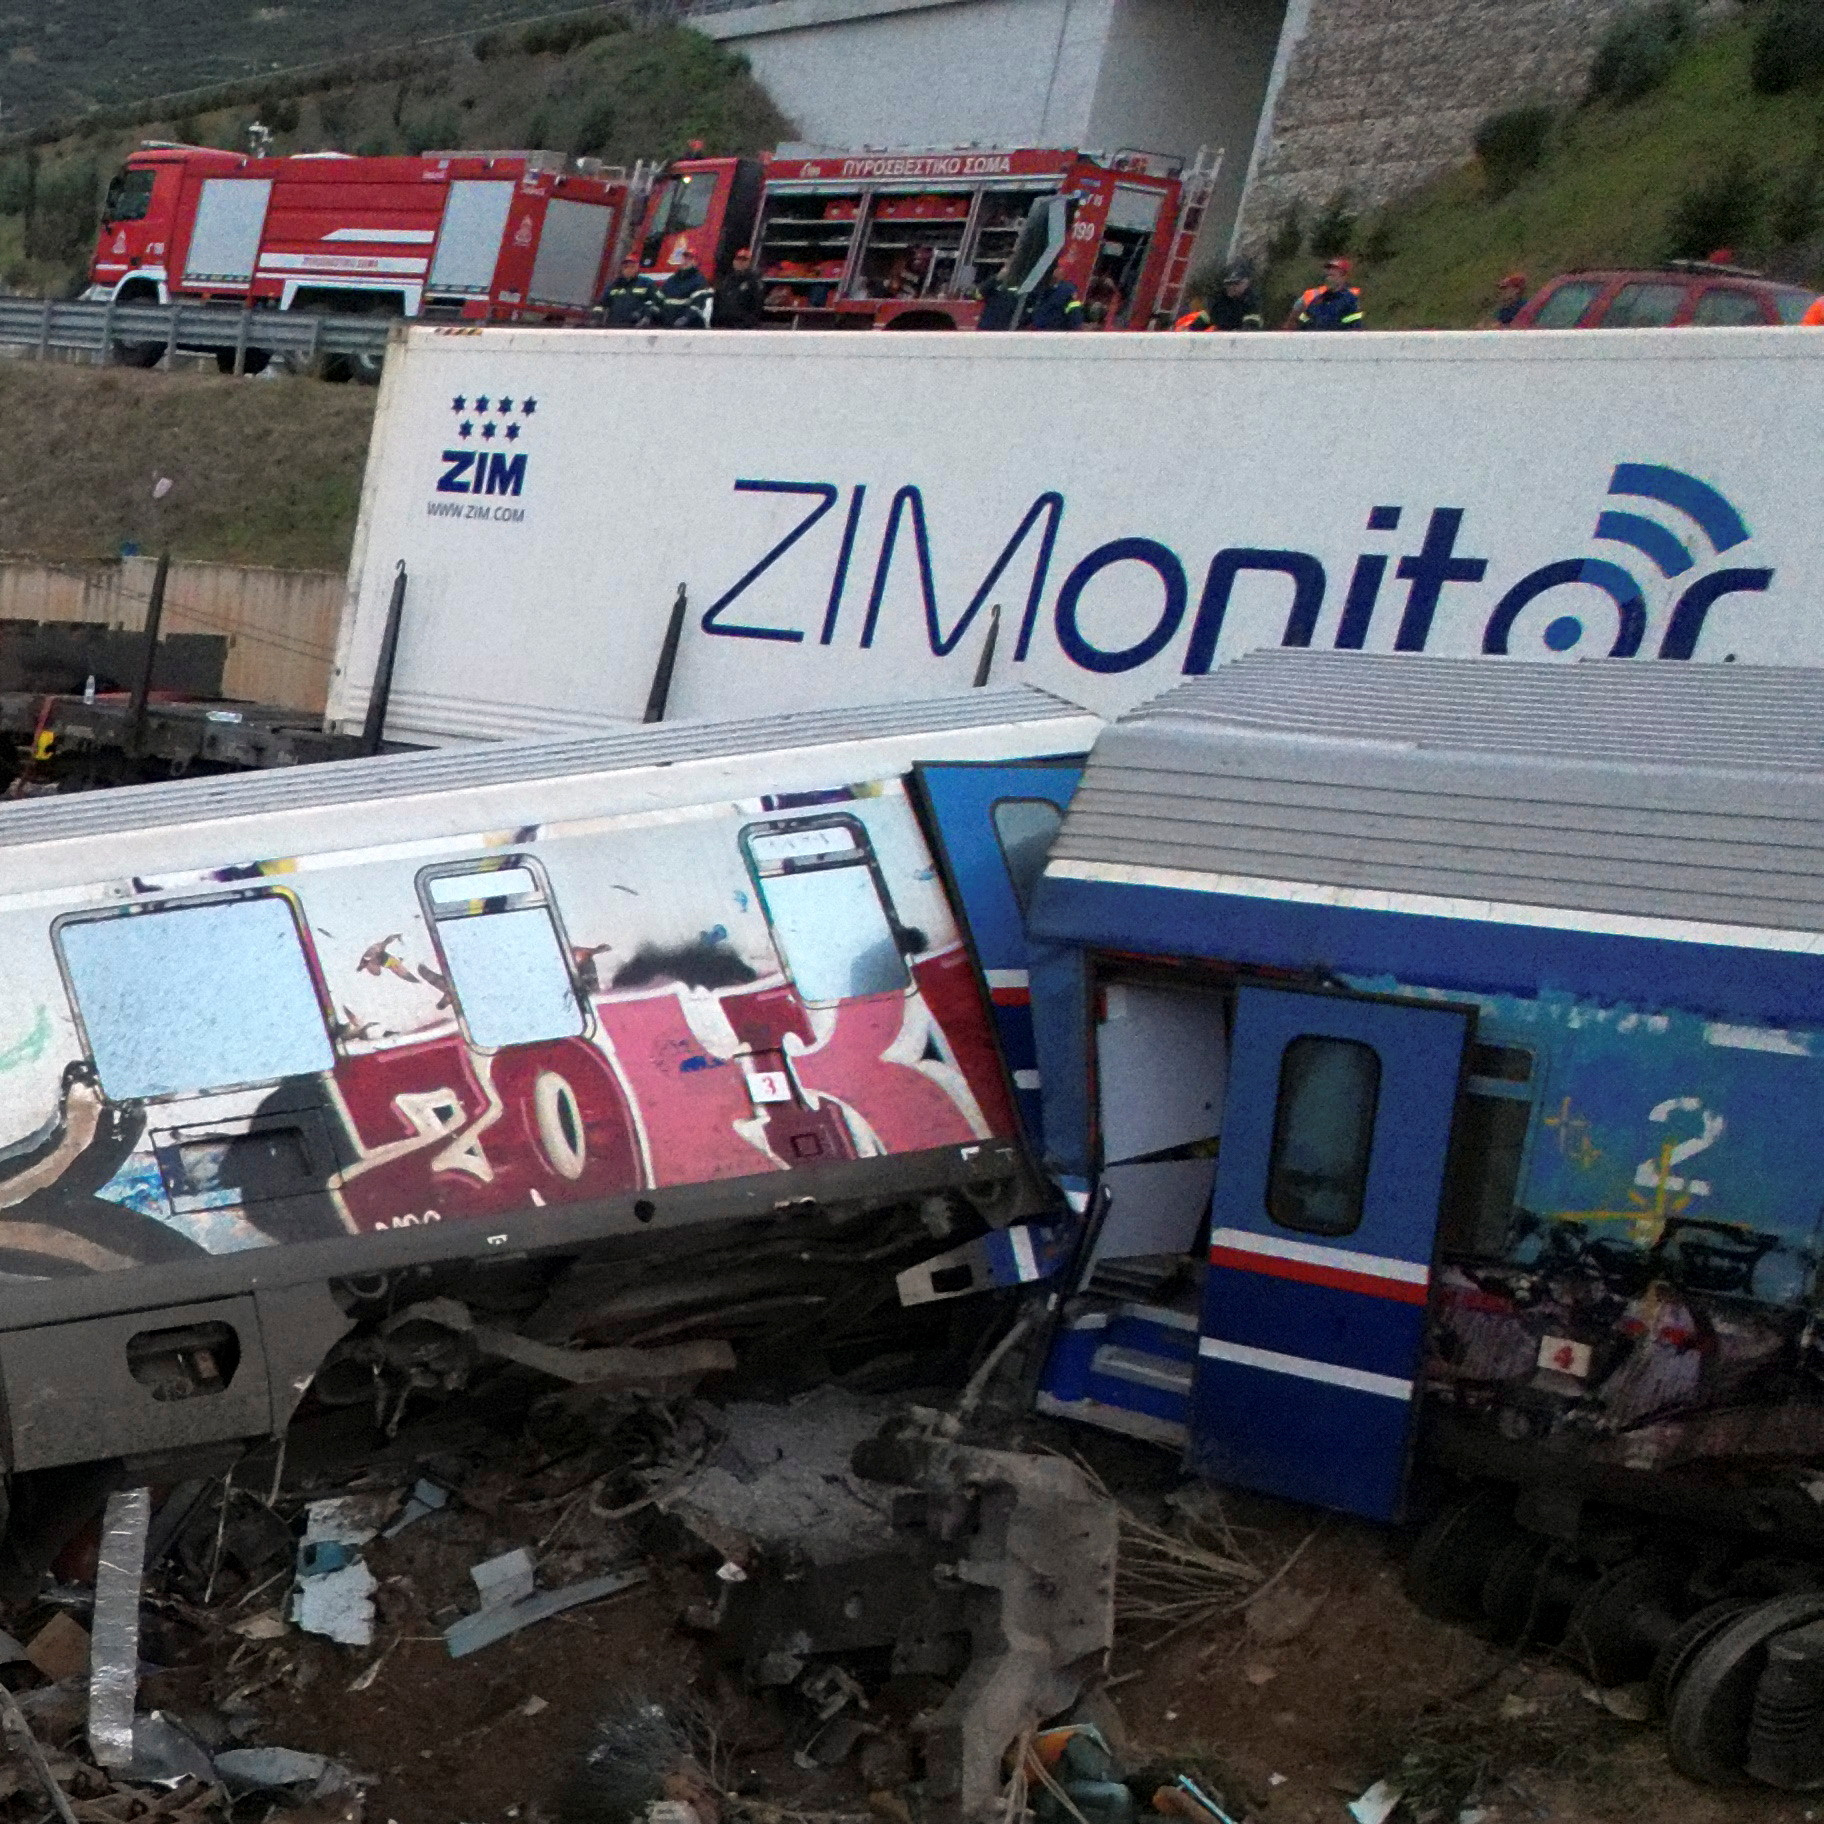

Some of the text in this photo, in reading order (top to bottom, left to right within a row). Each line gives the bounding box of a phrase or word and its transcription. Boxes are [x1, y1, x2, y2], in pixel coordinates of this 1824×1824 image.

[841, 158, 961, 176] ΠΥΡΟΣΒΕΣΤΙΚΟ
[436, 450, 528, 496] ZIM
[702, 478, 1774, 675] ZIMonitor
[762, 1076, 777, 1096] 3
[1634, 1097, 1725, 1197] 2
